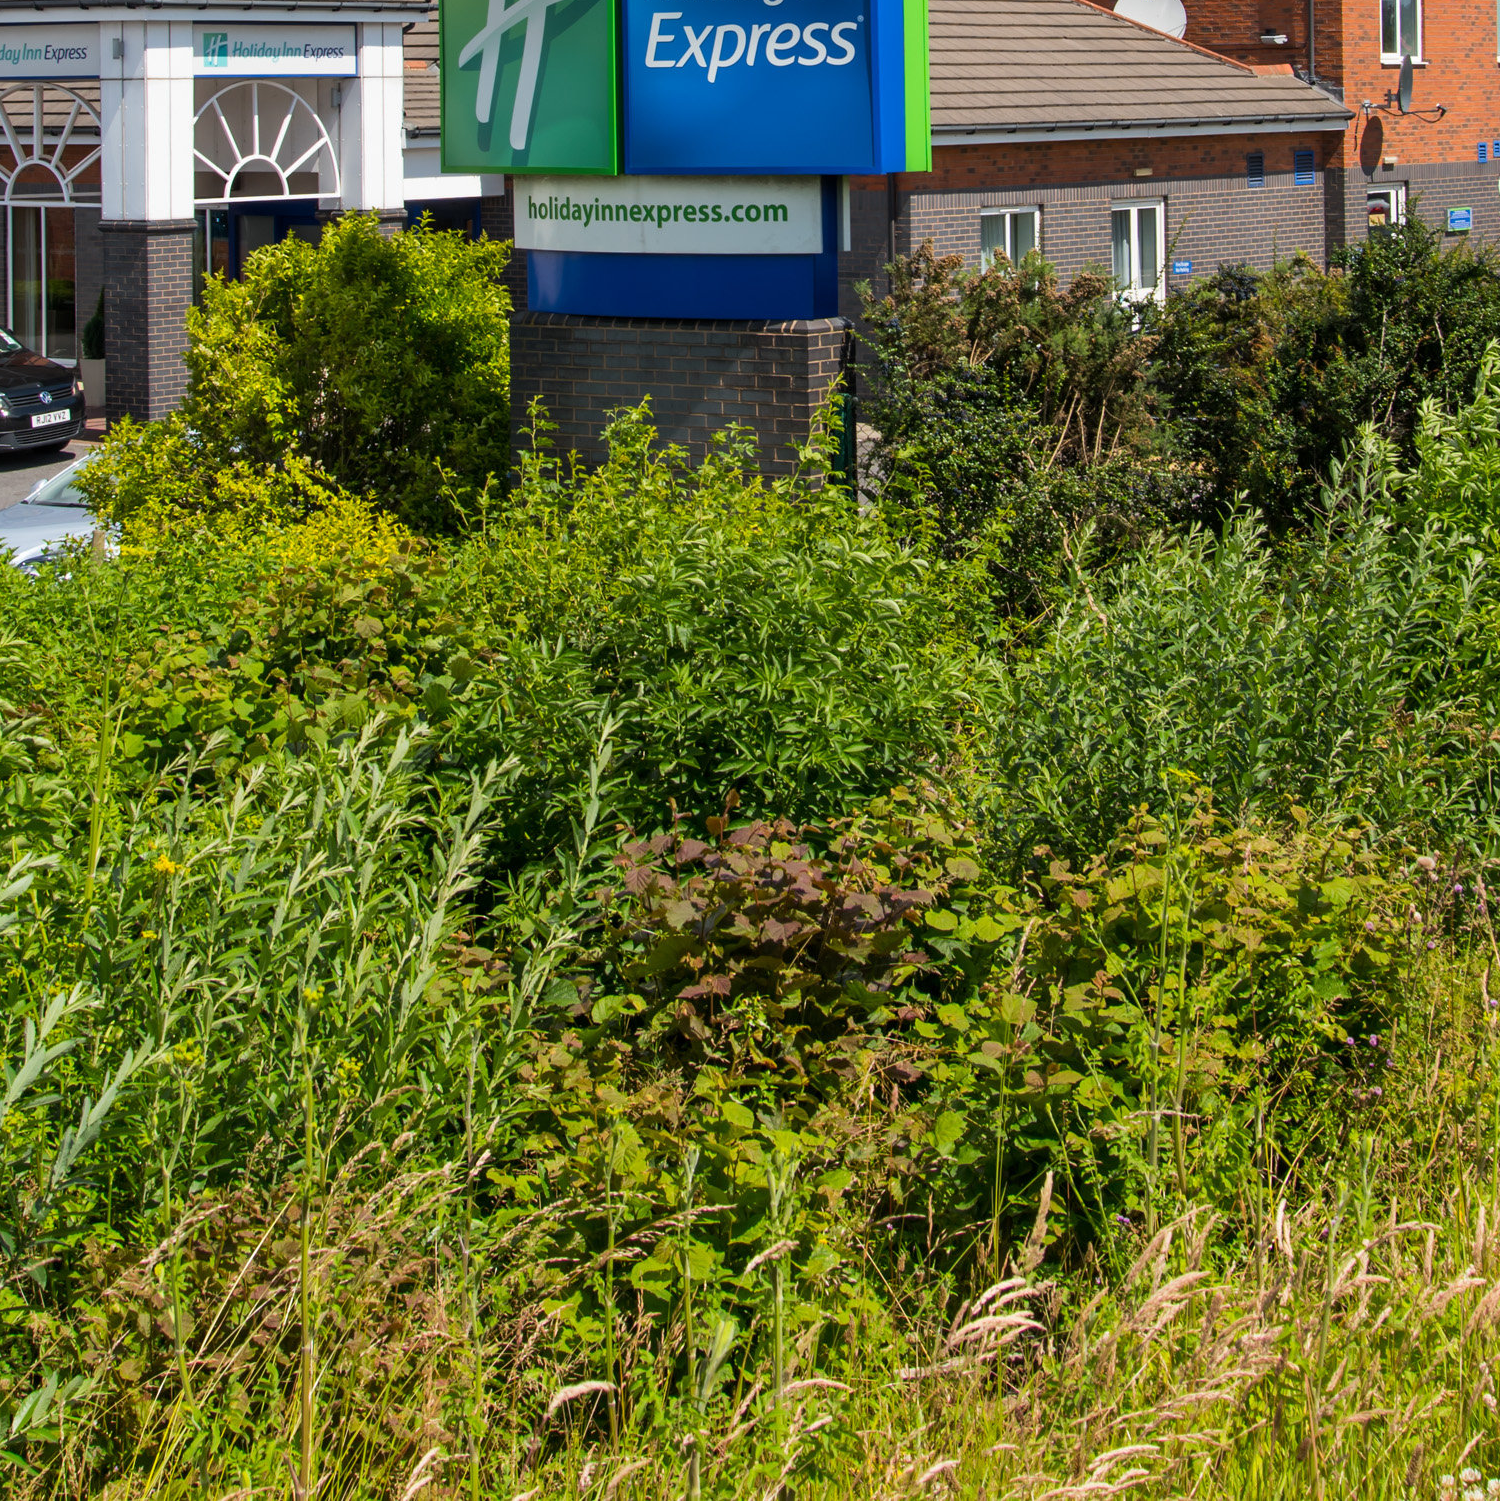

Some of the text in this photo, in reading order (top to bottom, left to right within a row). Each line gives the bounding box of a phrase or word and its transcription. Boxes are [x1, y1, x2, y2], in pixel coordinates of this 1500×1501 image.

[22, 42, 42, 60] Inn
[44, 44, 88, 64] Express
[232, 41, 344, 63] Holiday Inn Express
[644, 11, 858, 84] Express
[528, 195, 788, 229] holidayinnexpress.com
